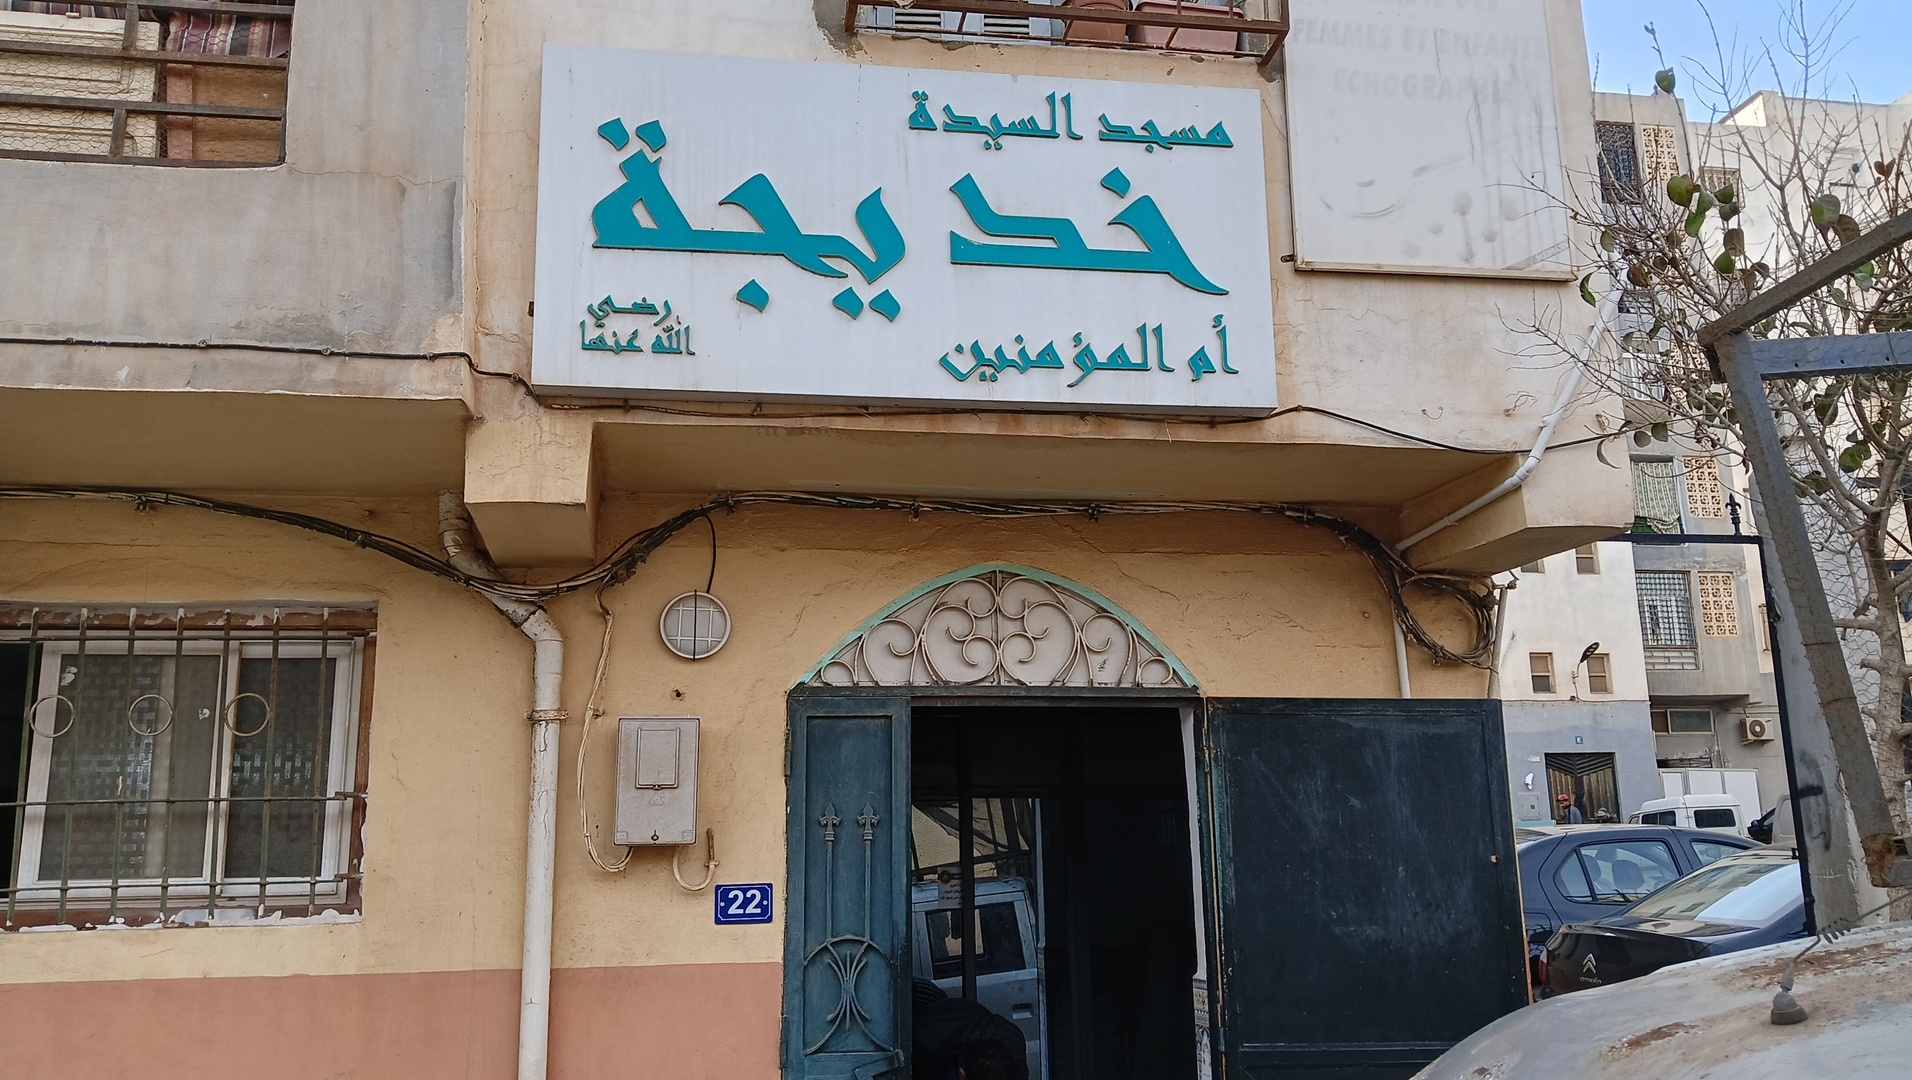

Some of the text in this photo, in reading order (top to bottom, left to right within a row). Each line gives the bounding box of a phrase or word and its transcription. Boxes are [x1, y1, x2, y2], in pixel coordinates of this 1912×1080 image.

[907, 90, 1234, 153] مسجد السيدة
[591, 117, 1229, 323] خديجة
[587, 294, 672, 328] رضي
[579, 319, 644, 355] عنها
[938, 313, 1239, 387] أم المؤمنين
[727, 889, 762, 915] 22
